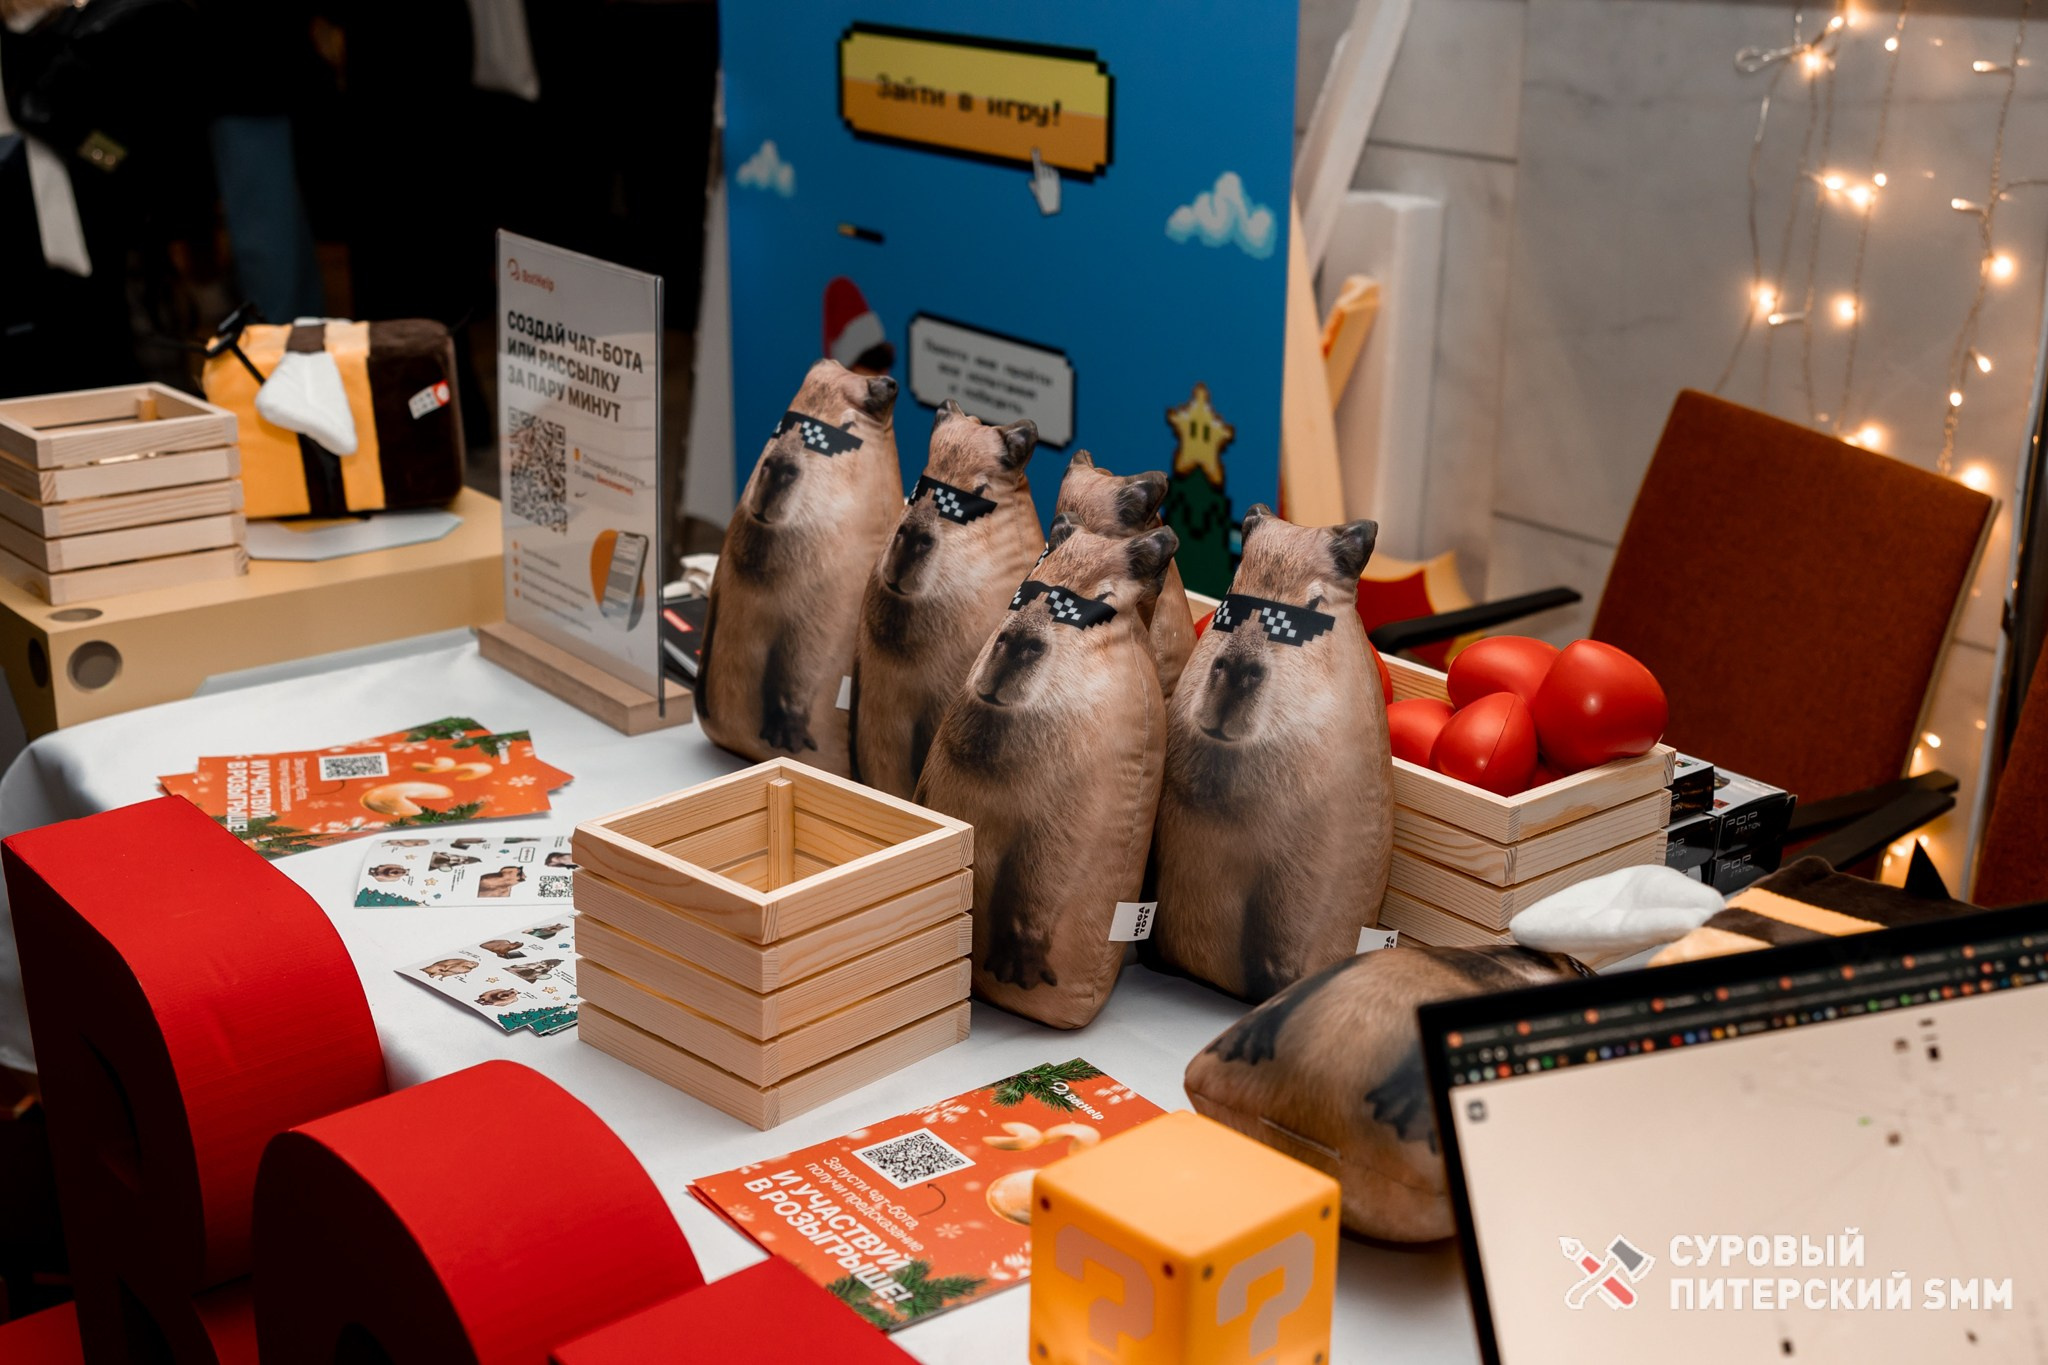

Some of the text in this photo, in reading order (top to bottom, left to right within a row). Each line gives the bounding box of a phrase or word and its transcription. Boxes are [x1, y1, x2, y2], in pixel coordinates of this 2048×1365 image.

[876, 73, 1062, 128] Зайти в игру!
[507, 309, 644, 374] СОЗДАЙ ЧАТ-БОТА
[507, 337, 621, 394] ИЛИ РАССЫЛКУ
[507, 365, 622, 423] ЗА ПАРУ МИНУТ
[250, 768, 277, 818] УЧАСТВУЙ
[1726, 811, 1758, 829] POP
[1666, 838, 1685, 853] OP
[1721, 854, 1752, 873] POP
[1133, 906, 1146, 937] MEGA
[1140, 908, 1151, 934] TOYS
[1064, 1093, 1104, 1120] BotHelp
[770, 1169, 914, 1272] И УЧАСТВУЙ
[804, 1162, 924, 1252] получи предсказание
[823, 1156, 919, 1231] Запусти чат-бота,
[744, 1177, 914, 1304] В РОЗЫГРЫШЕ!
